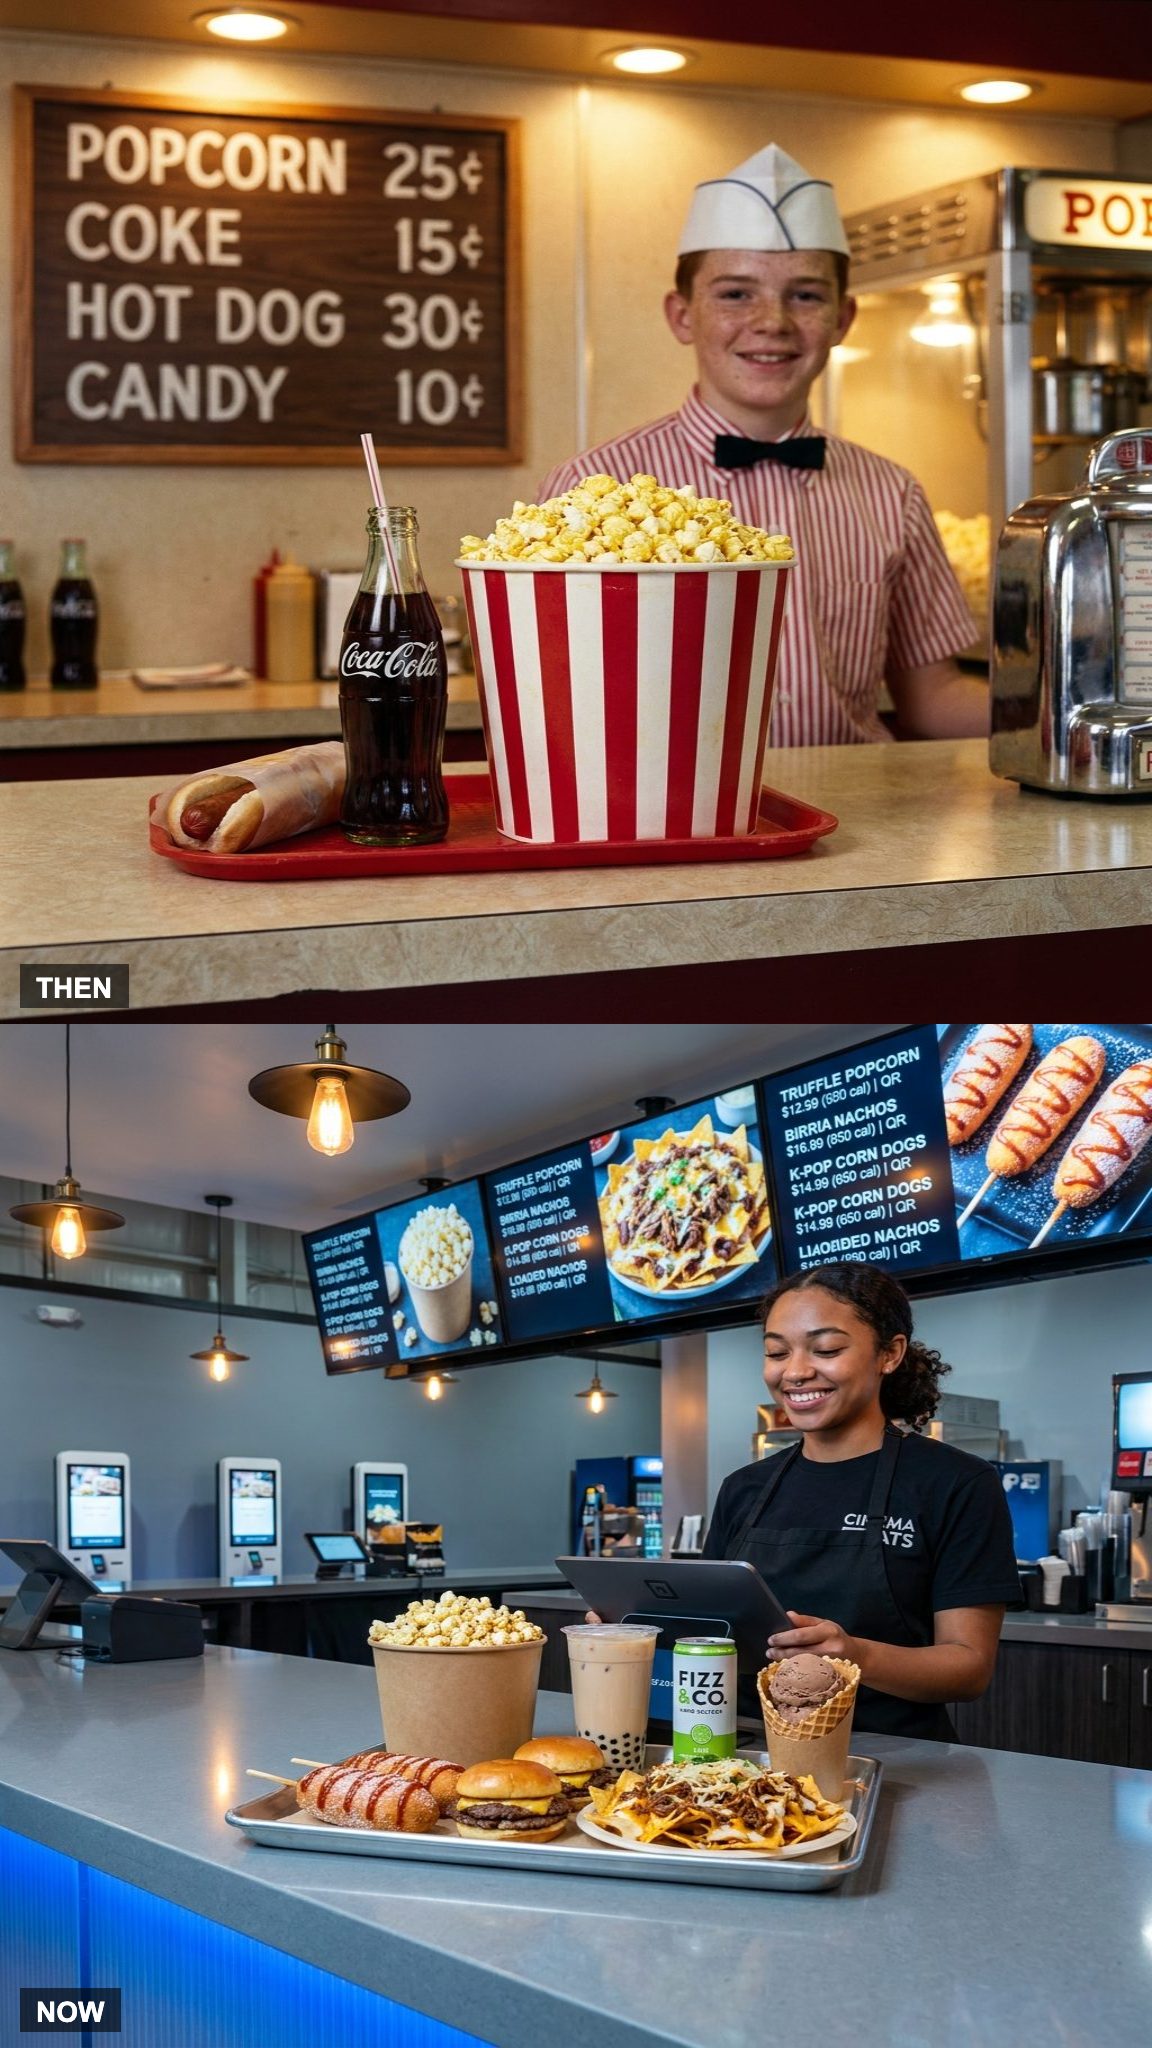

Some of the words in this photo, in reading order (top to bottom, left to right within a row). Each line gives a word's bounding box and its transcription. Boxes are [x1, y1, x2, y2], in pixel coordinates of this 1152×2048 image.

[67, 122, 347, 195] POPCORN
[383, 143, 484, 201] 25¢
[66, 202, 242, 266] COKE
[394, 217, 484, 275] 15¢
[67, 282, 192, 342] HOT
[216, 287, 345, 347] DOG
[382, 293, 484, 350] 30¢
[66, 361, 288, 422] CANDY
[394, 369, 484, 425] 10¢
[341, 641, 438, 678] Coca-Cola
[780, 1072, 842, 1103] TRUFFLE
[845, 1047, 920, 1083] POPCORN
[849, 1081, 871, 1097] cal)
[881, 1072, 902, 1087] QR
[785, 1118, 832, 1142] BIRRIA
[834, 1099, 898, 1128] NACHOS
[854, 1123, 876, 1139] cal)
[885, 1114, 907, 1130] QR
[494, 1173, 534, 1195] TRUFFLE
[535, 1158, 582, 1182] POPCORN
[789, 1160, 833, 1181] K-POP
[835, 1147, 878, 1170] CORN
[882, 1134, 926, 1158] DOGS
[791, 1177, 829, 1197] $14.99
[860, 1164, 881, 1180] cal)
[890, 1156, 912, 1172] QR
[794, 1199, 838, 1220] K-POP
[841, 1187, 883, 1209] CORN
[887, 1176, 932, 1199] DOGS
[864, 1206, 886, 1220] cal)
[896, 1199, 917, 1214] QR
[869, 1246, 891, 1260] cal)
[900, 1240, 921, 1255] QR
[875, 1219, 940, 1244] NACHOS
[844, 1513, 915, 1532] CIMA
[678, 1670, 725, 1688] FIZZ
